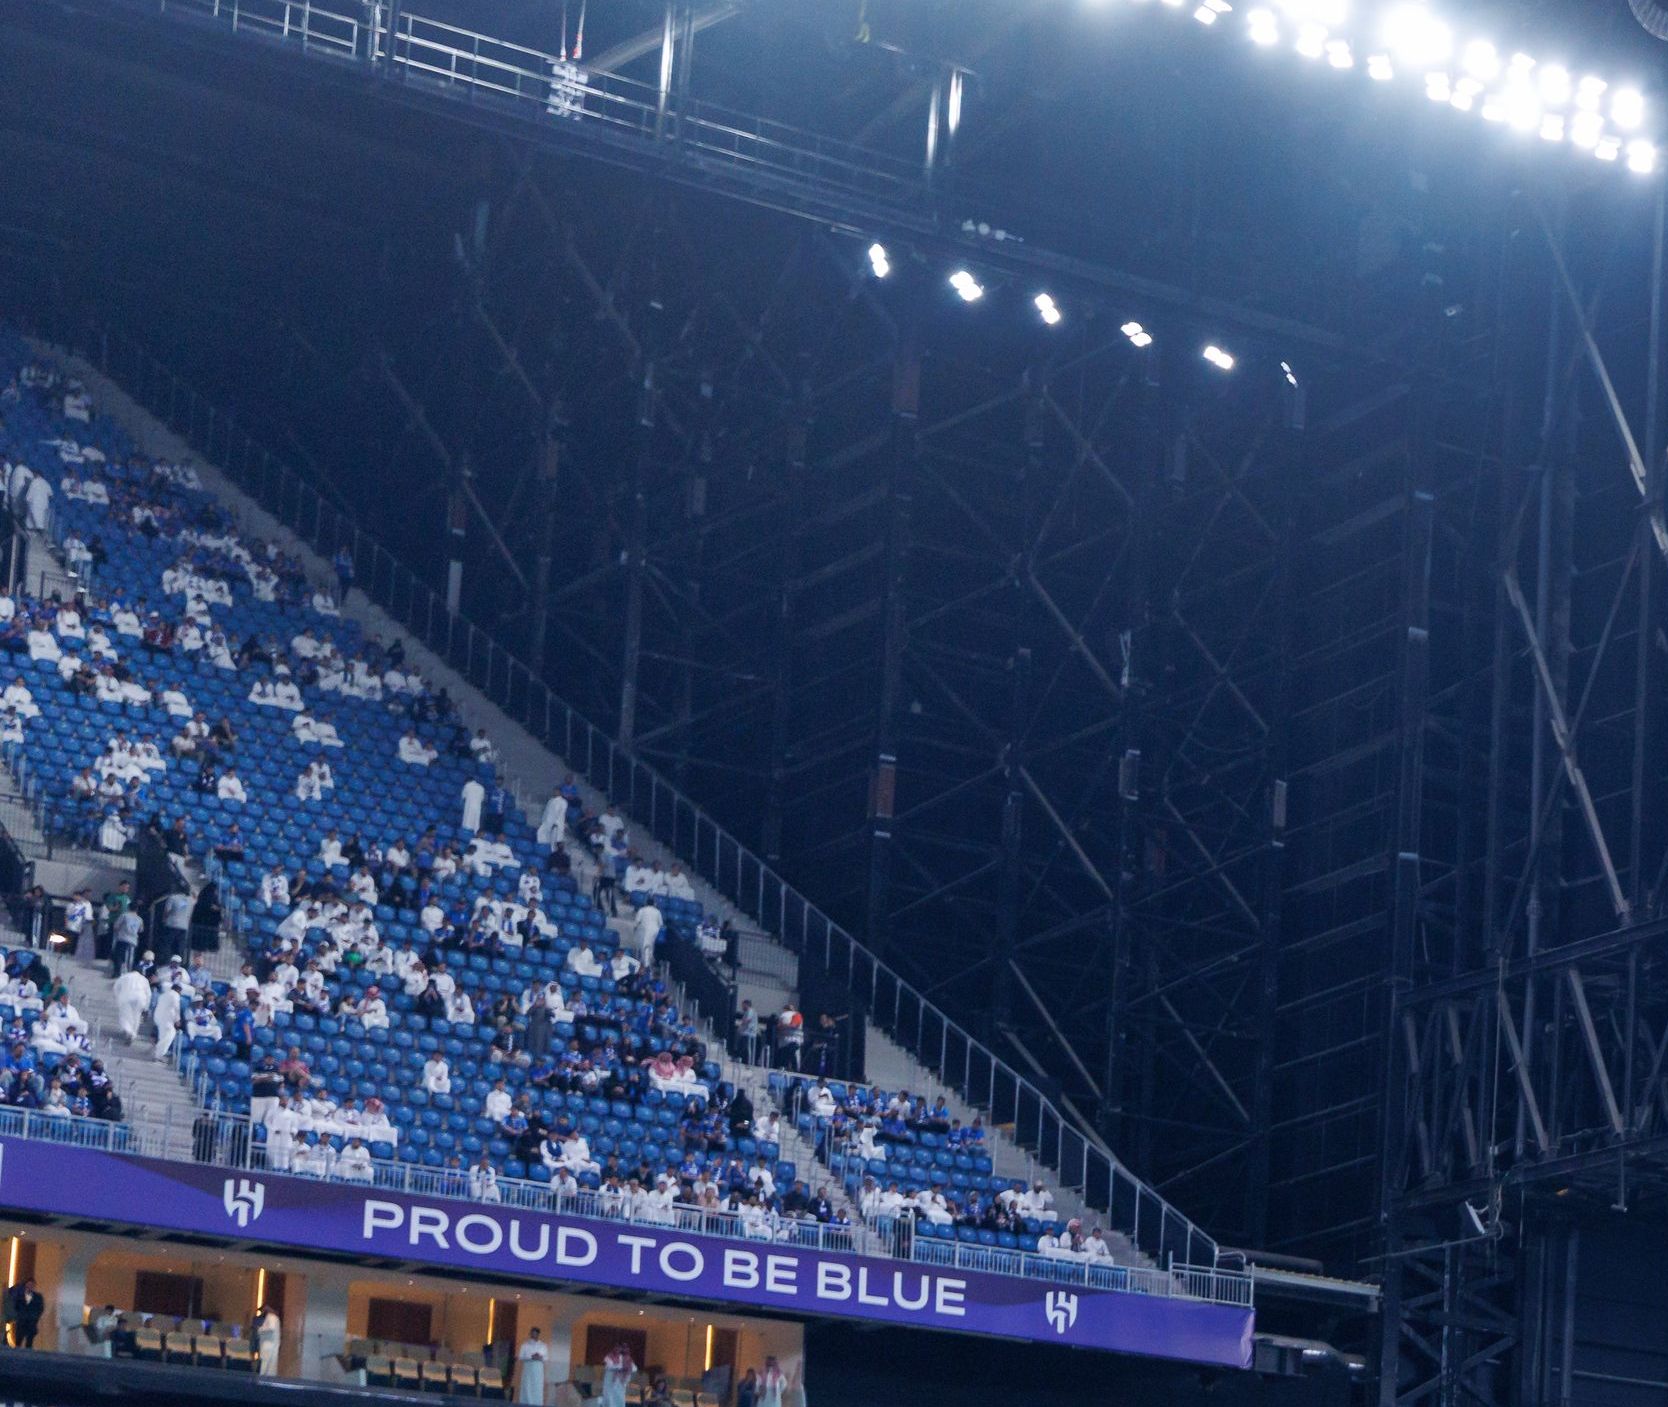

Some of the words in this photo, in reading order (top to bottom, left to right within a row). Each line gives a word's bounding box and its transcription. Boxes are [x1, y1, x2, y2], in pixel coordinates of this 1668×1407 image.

[362, 1198, 598, 1267] PROUD
[617, 1235, 706, 1282] TO
[723, 1248, 800, 1295] BE
[816, 1260, 968, 1317] BLUE
